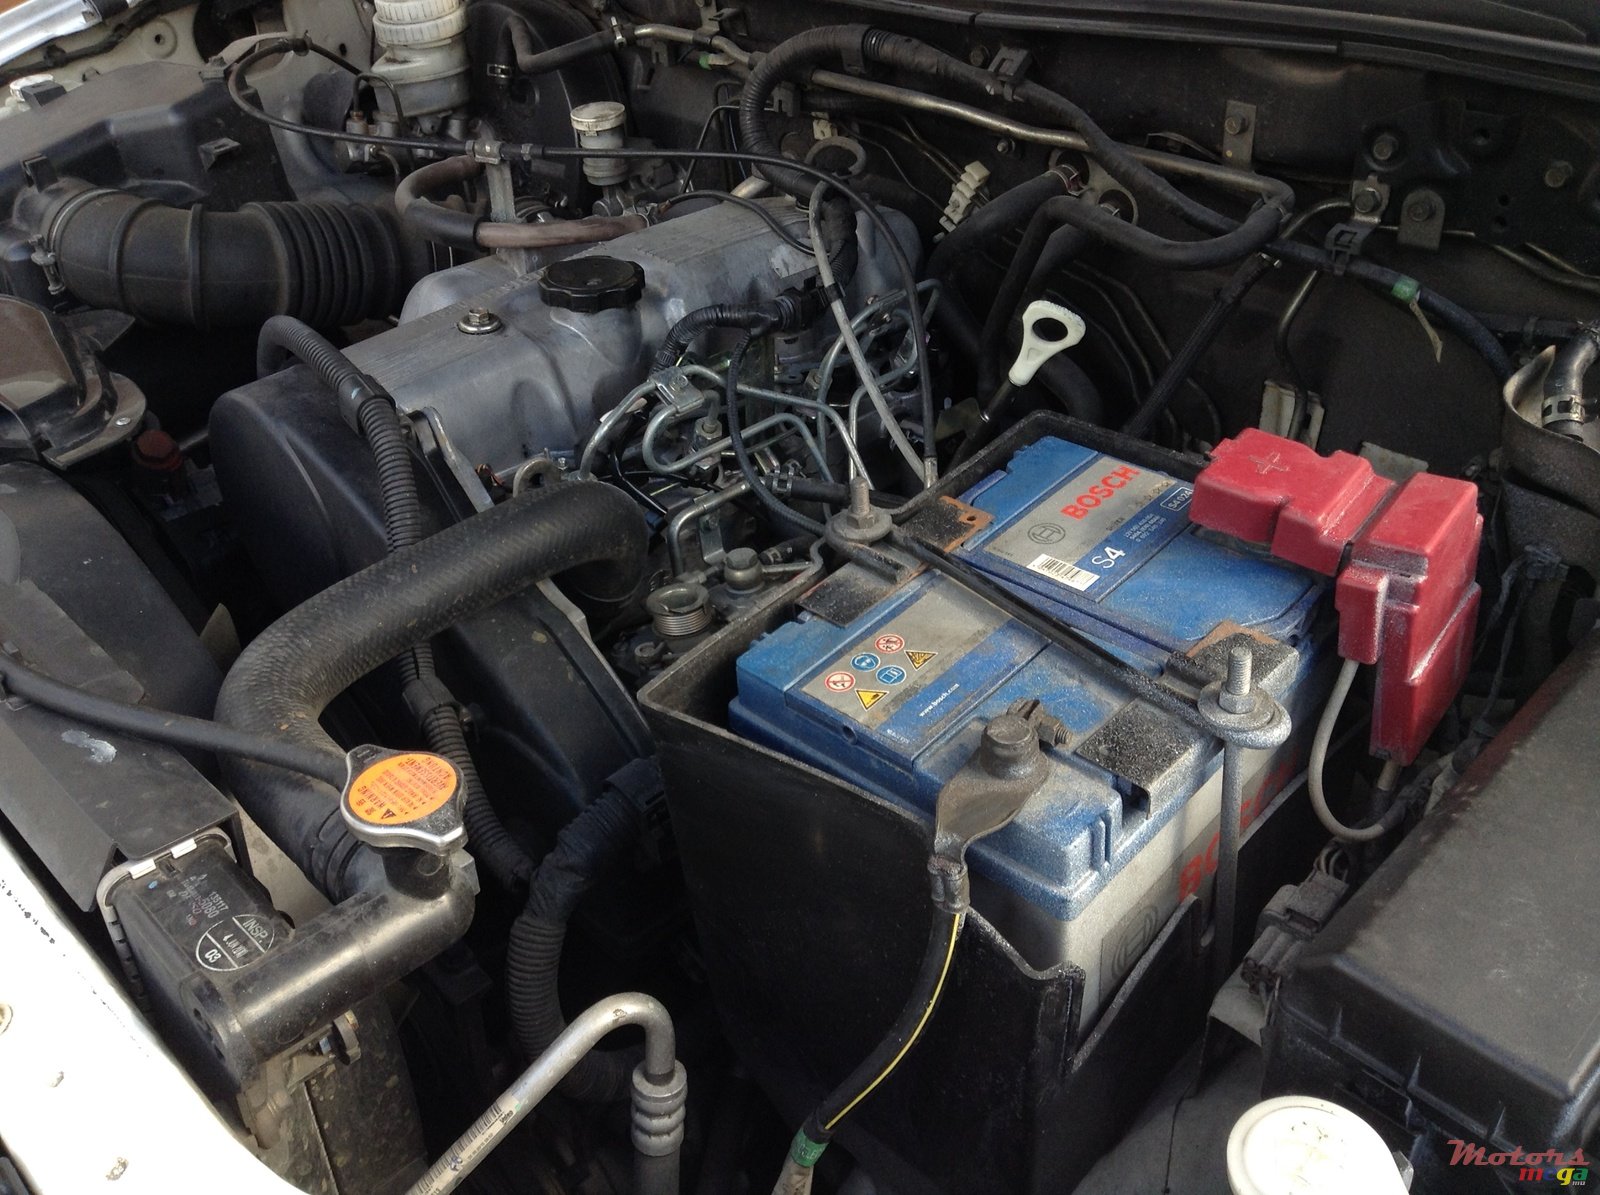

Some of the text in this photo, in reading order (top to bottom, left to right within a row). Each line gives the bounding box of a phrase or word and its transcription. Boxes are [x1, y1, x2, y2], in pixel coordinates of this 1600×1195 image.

[1060, 466, 1140, 520] BOSCH
[1091, 546, 1126, 569] S4
[919, 683, 960, 717] www.bosch.com
[242, 918, 269, 943] INSP.
[204, 948, 222, 963] 03
